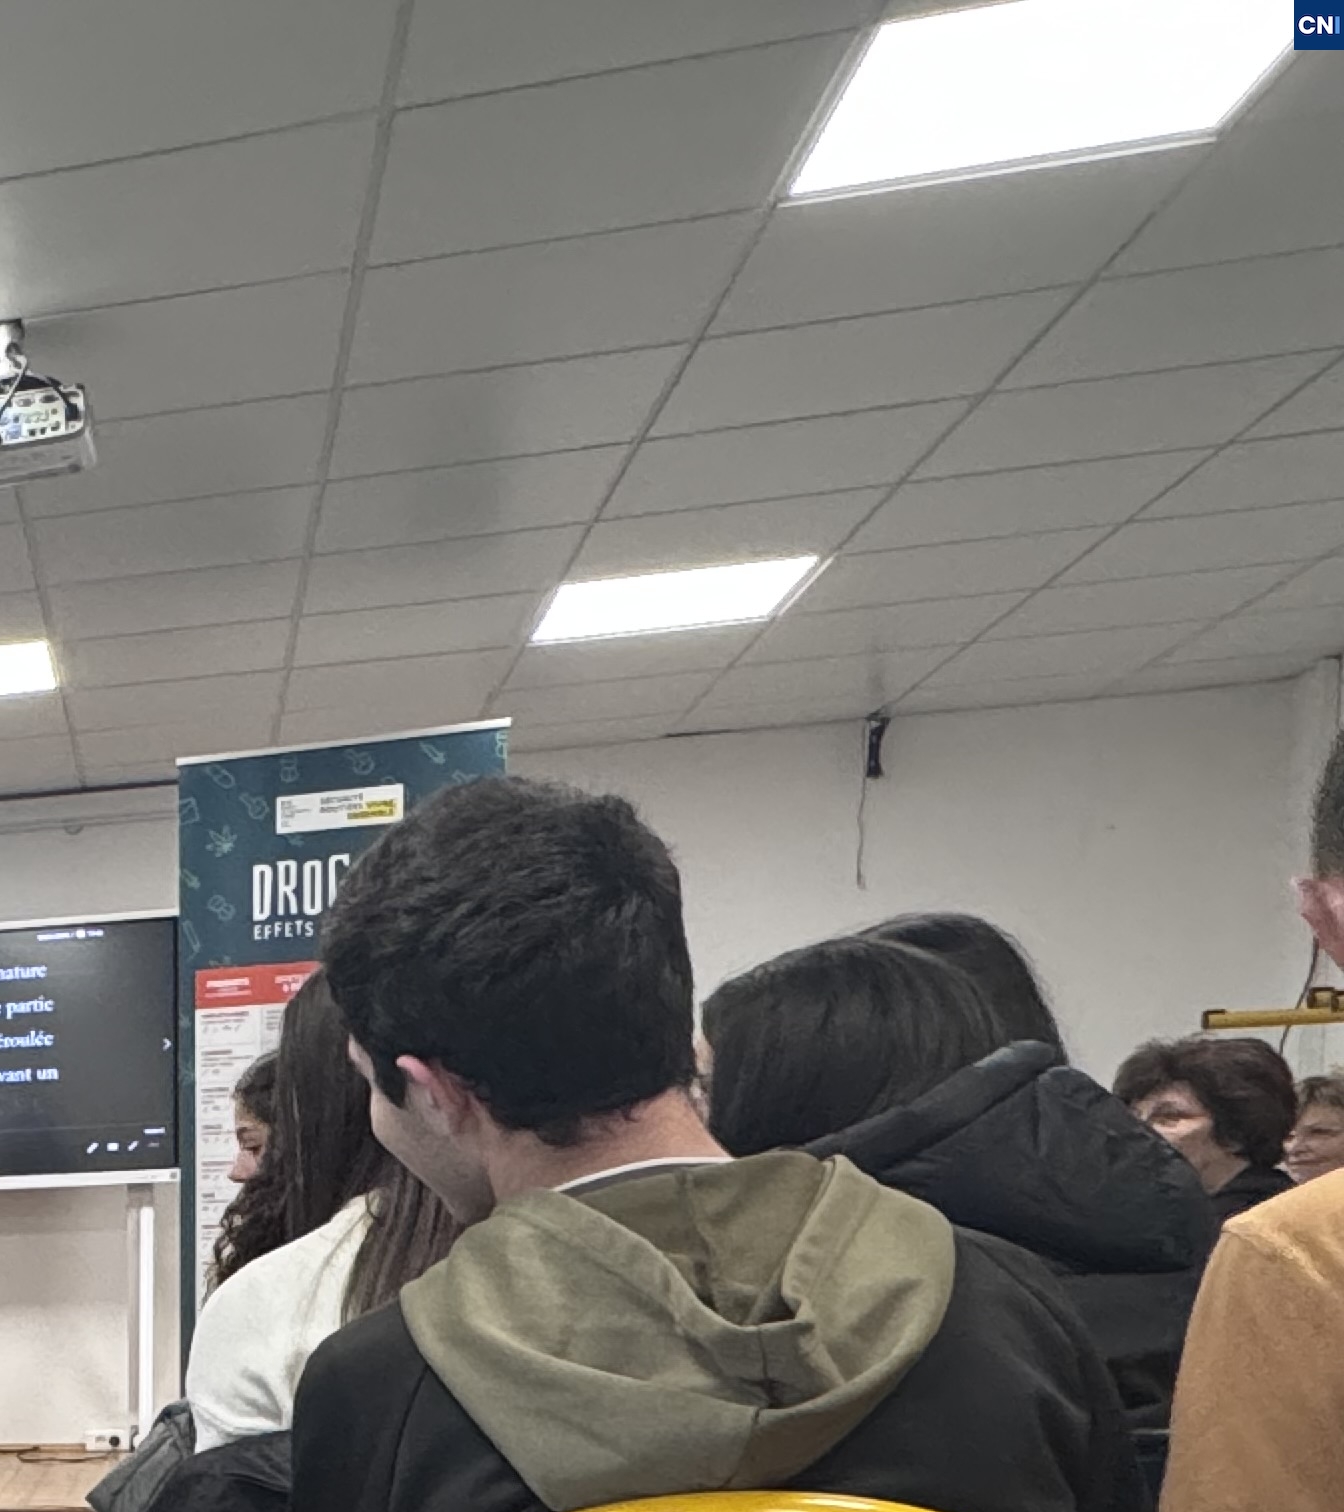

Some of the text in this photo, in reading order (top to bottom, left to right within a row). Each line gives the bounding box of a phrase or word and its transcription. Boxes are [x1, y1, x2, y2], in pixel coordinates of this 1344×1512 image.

[253, 919, 314, 940] EFFETS
[5, 995, 55, 1020] partie
[36, 1067, 59, 1081] un
